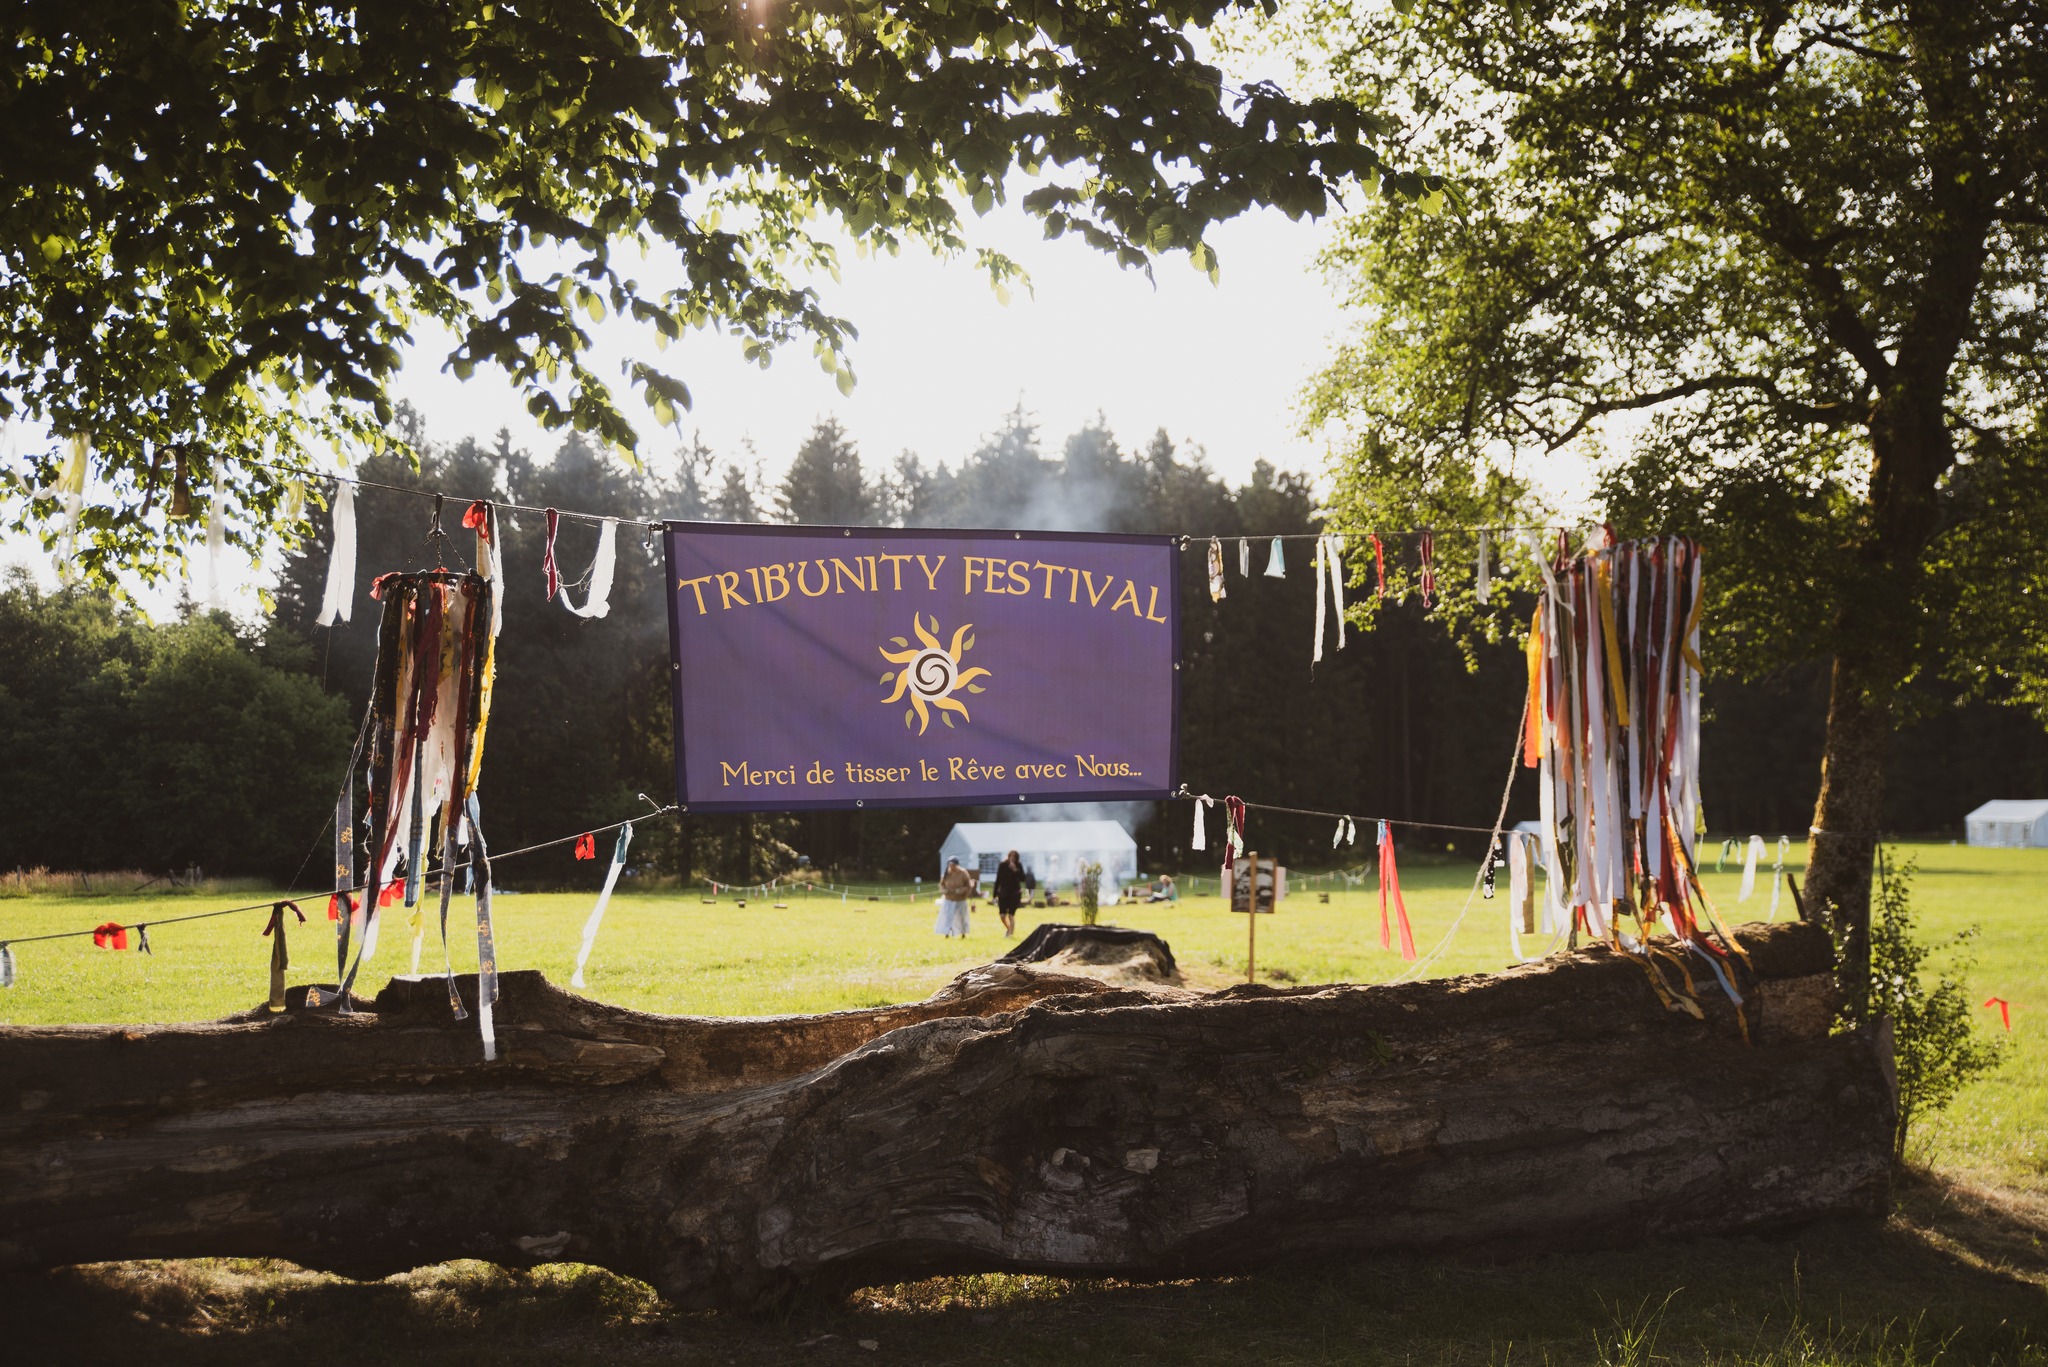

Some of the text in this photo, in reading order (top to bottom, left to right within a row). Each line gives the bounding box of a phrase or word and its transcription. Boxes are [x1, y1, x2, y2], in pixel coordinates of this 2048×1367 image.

[963, 556, 1168, 624] FESTIVAL
[719, 761, 796, 786] Merci
[806, 760, 834, 785] de
[845, 762, 911, 783] tisser
[919, 759, 939, 782] le
[947, 757, 1006, 781] Rêve
[1015, 763, 1067, 779] avec
